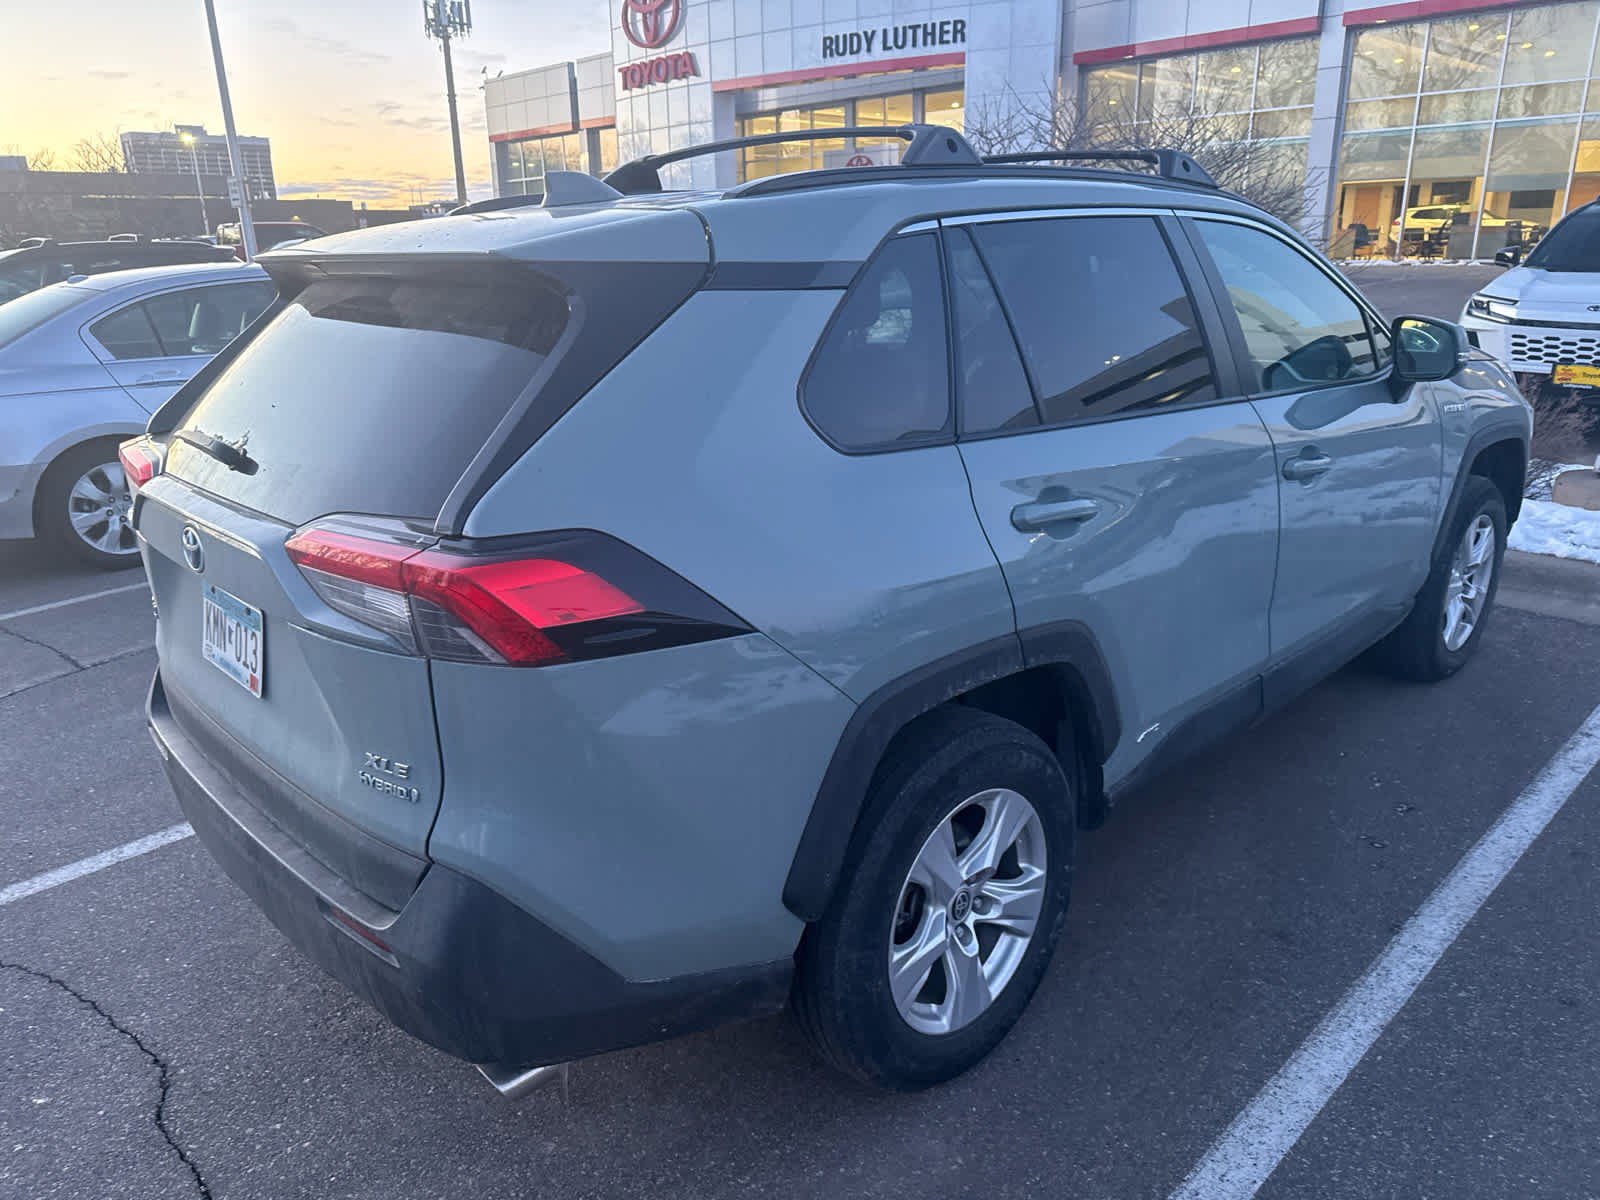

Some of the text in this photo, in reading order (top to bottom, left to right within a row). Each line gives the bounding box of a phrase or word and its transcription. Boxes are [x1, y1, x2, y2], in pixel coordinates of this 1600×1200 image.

[822, 19, 966, 59] RUDY LUTHER
[618, 51, 697, 90] TOYOTA
[235, 620, 258, 675] 013
[364, 751, 410, 779] XLE
[358, 770, 409, 801] HYBRID
